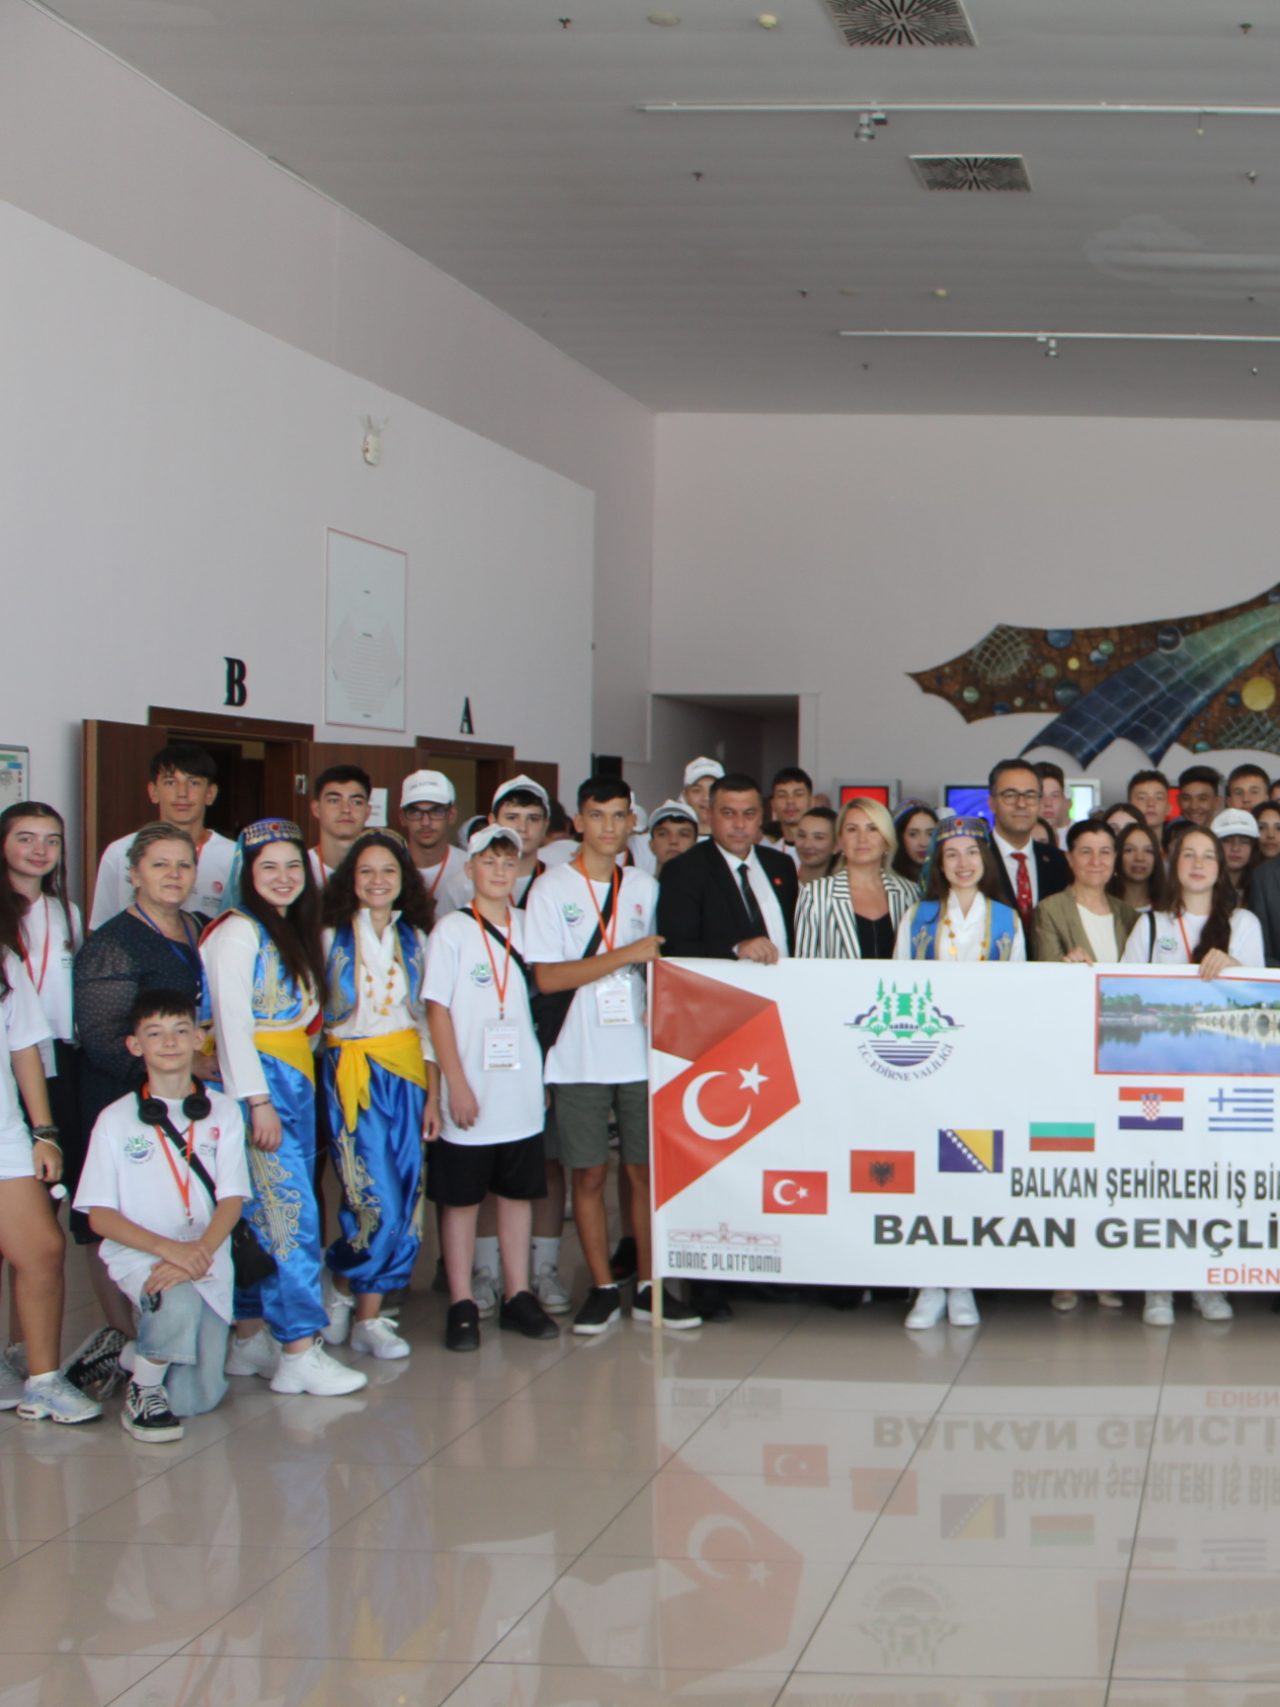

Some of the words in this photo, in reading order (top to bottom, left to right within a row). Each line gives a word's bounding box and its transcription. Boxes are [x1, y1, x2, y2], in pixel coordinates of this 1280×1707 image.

[223, 656, 247, 707] B
[459, 696, 475, 735] A
[870, 1059, 912, 1081] EDİRNE
[1011, 1166, 1098, 1198] BALKAN
[1106, 1160, 1219, 1207] ŞEHİRLERİ
[1226, 1162, 1247, 1208] İŞ
[873, 1213, 1077, 1249] BALKAN
[712, 1253, 782, 1273] PLATFORMU
